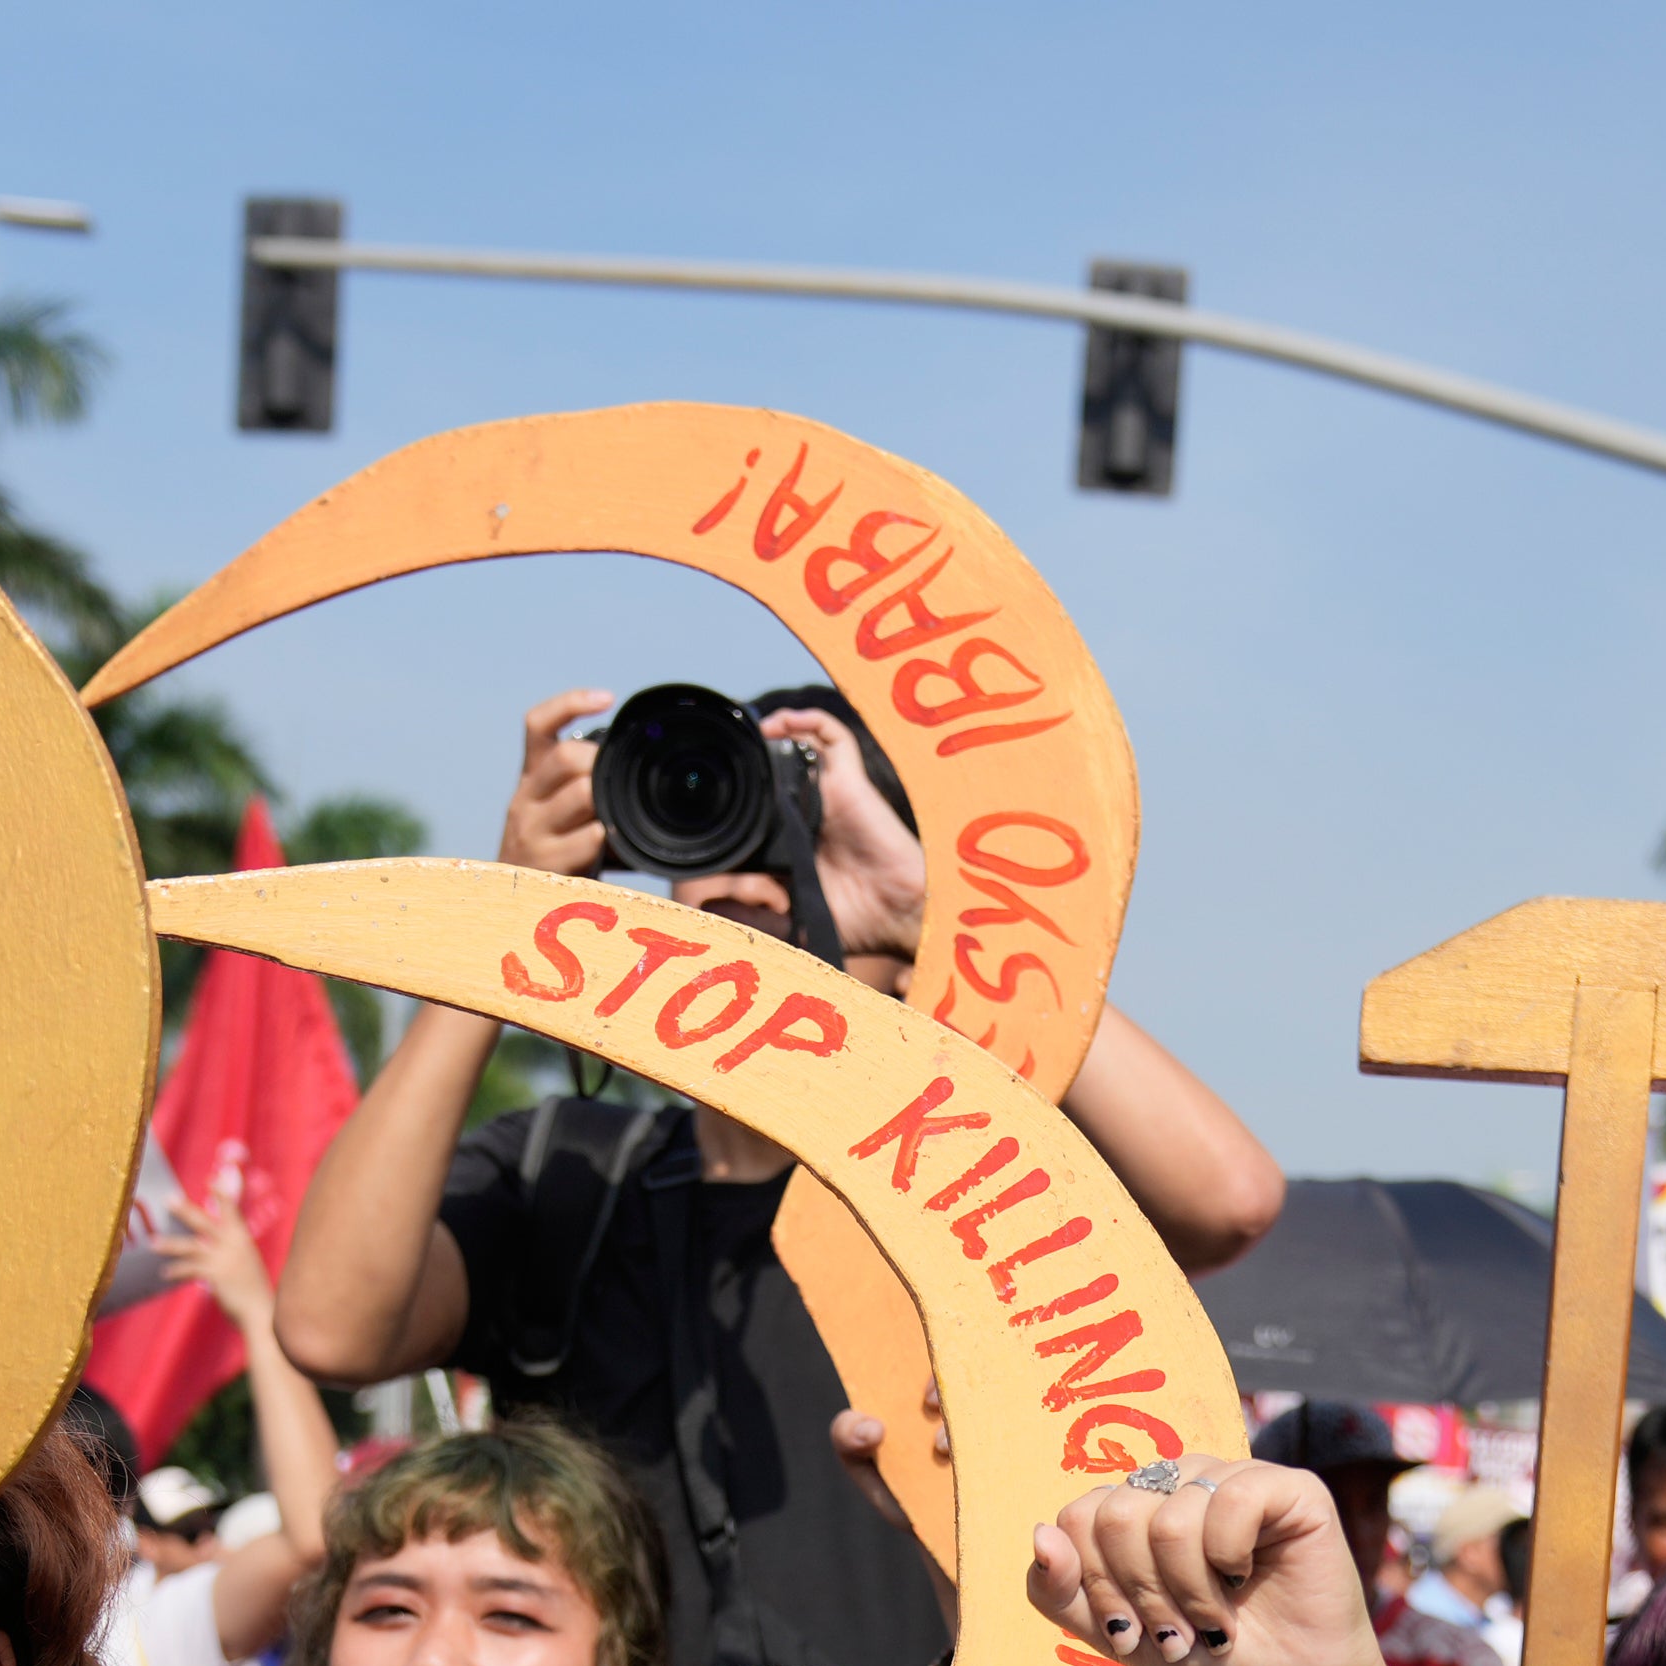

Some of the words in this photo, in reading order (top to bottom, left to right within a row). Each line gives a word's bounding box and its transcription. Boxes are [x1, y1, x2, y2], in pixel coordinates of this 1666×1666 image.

[691, 441, 1075, 758] IBABA!
[501, 901, 850, 1075] STOP
[848, 1076, 1184, 1474] KILLING
